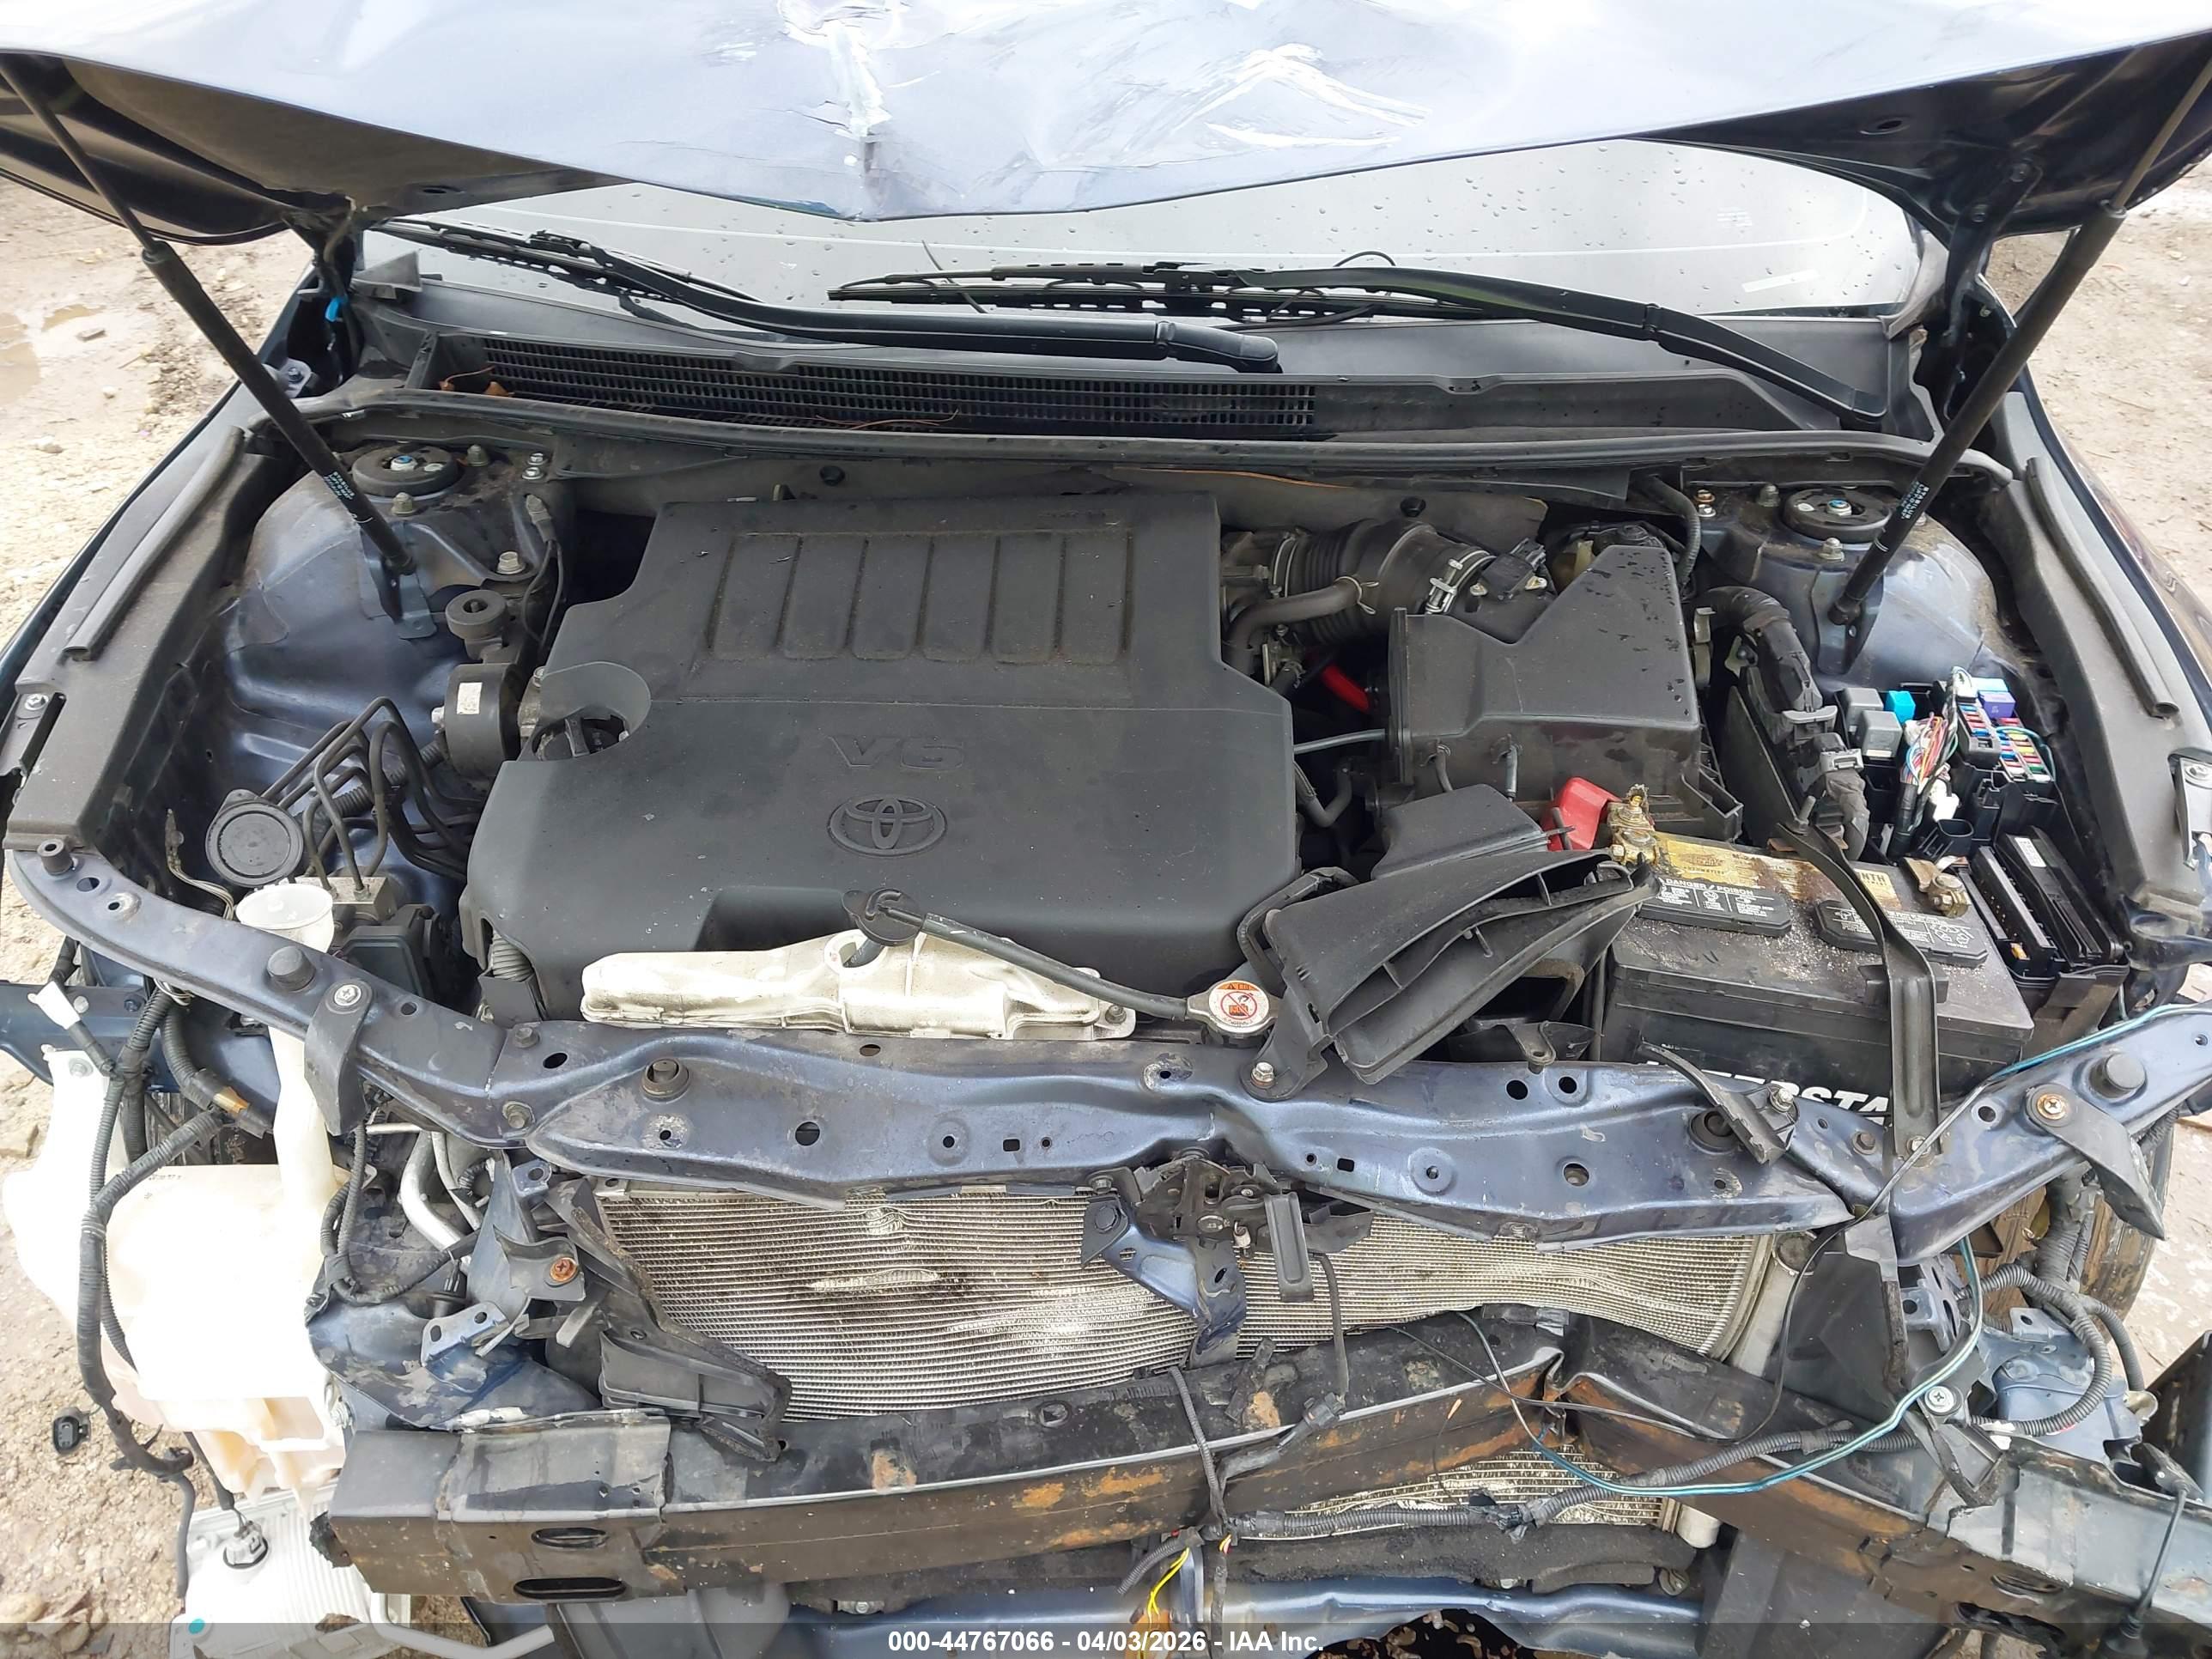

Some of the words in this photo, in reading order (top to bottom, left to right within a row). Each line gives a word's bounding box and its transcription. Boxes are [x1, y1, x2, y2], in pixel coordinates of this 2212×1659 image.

[826, 734, 965, 769] V6
[1666, 878, 1706, 890] DANGER
[1717, 885, 1753, 896] POISON
